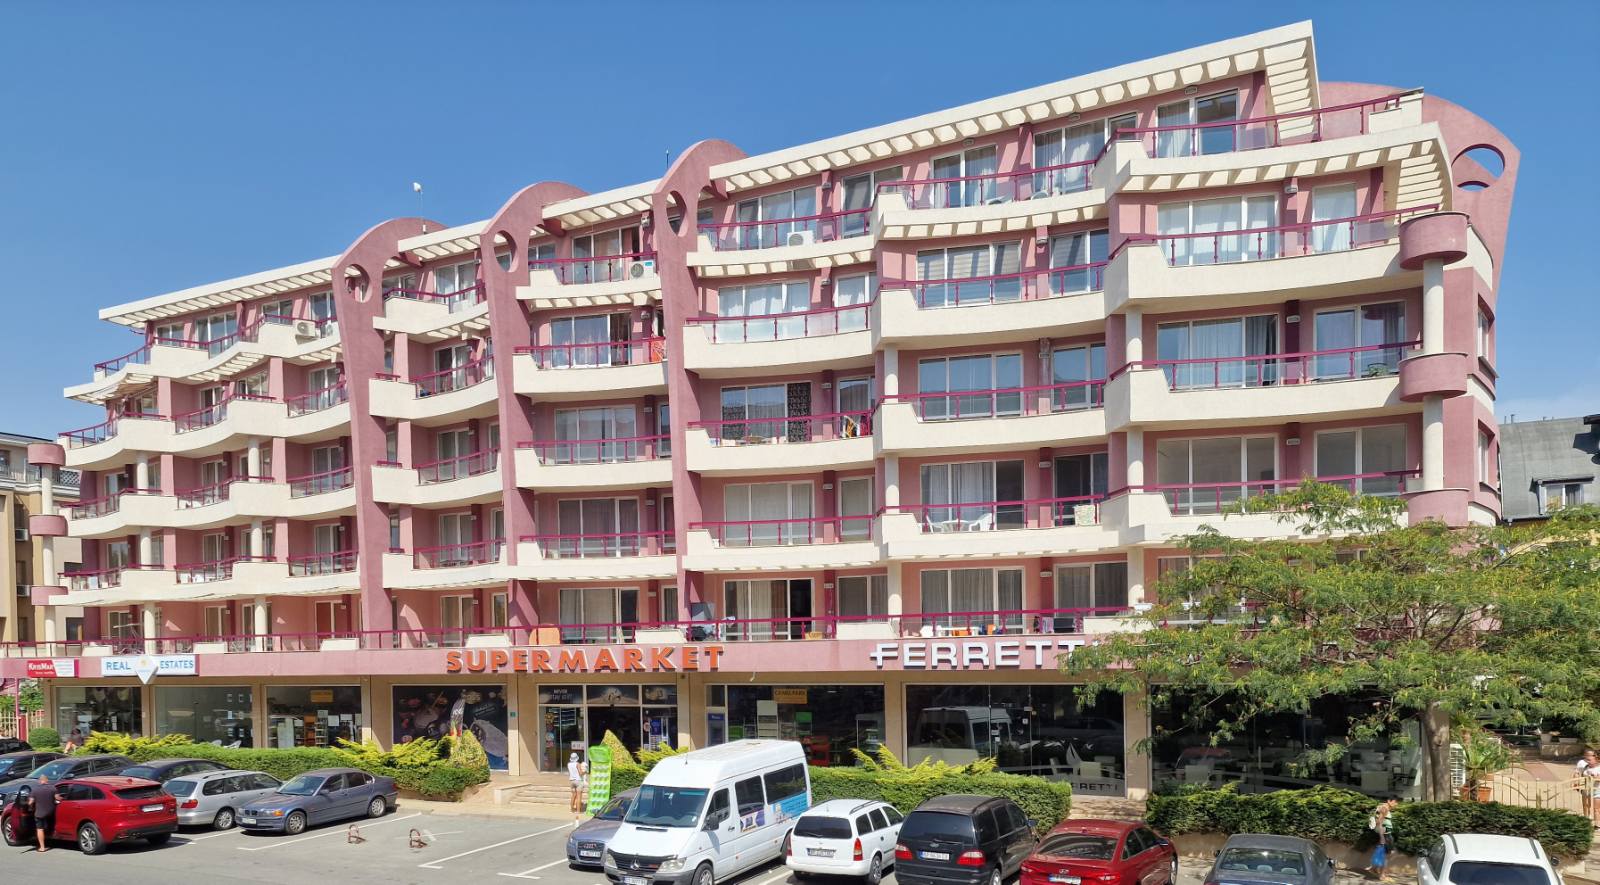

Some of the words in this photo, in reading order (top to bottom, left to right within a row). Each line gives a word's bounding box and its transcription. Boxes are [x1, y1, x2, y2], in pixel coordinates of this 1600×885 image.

[106, 661, 131, 670] REAL
[160, 660, 194, 669] ESTATES
[446, 645, 724, 673] SUPERMARKET
[870, 640, 1100, 669] FERRETT
